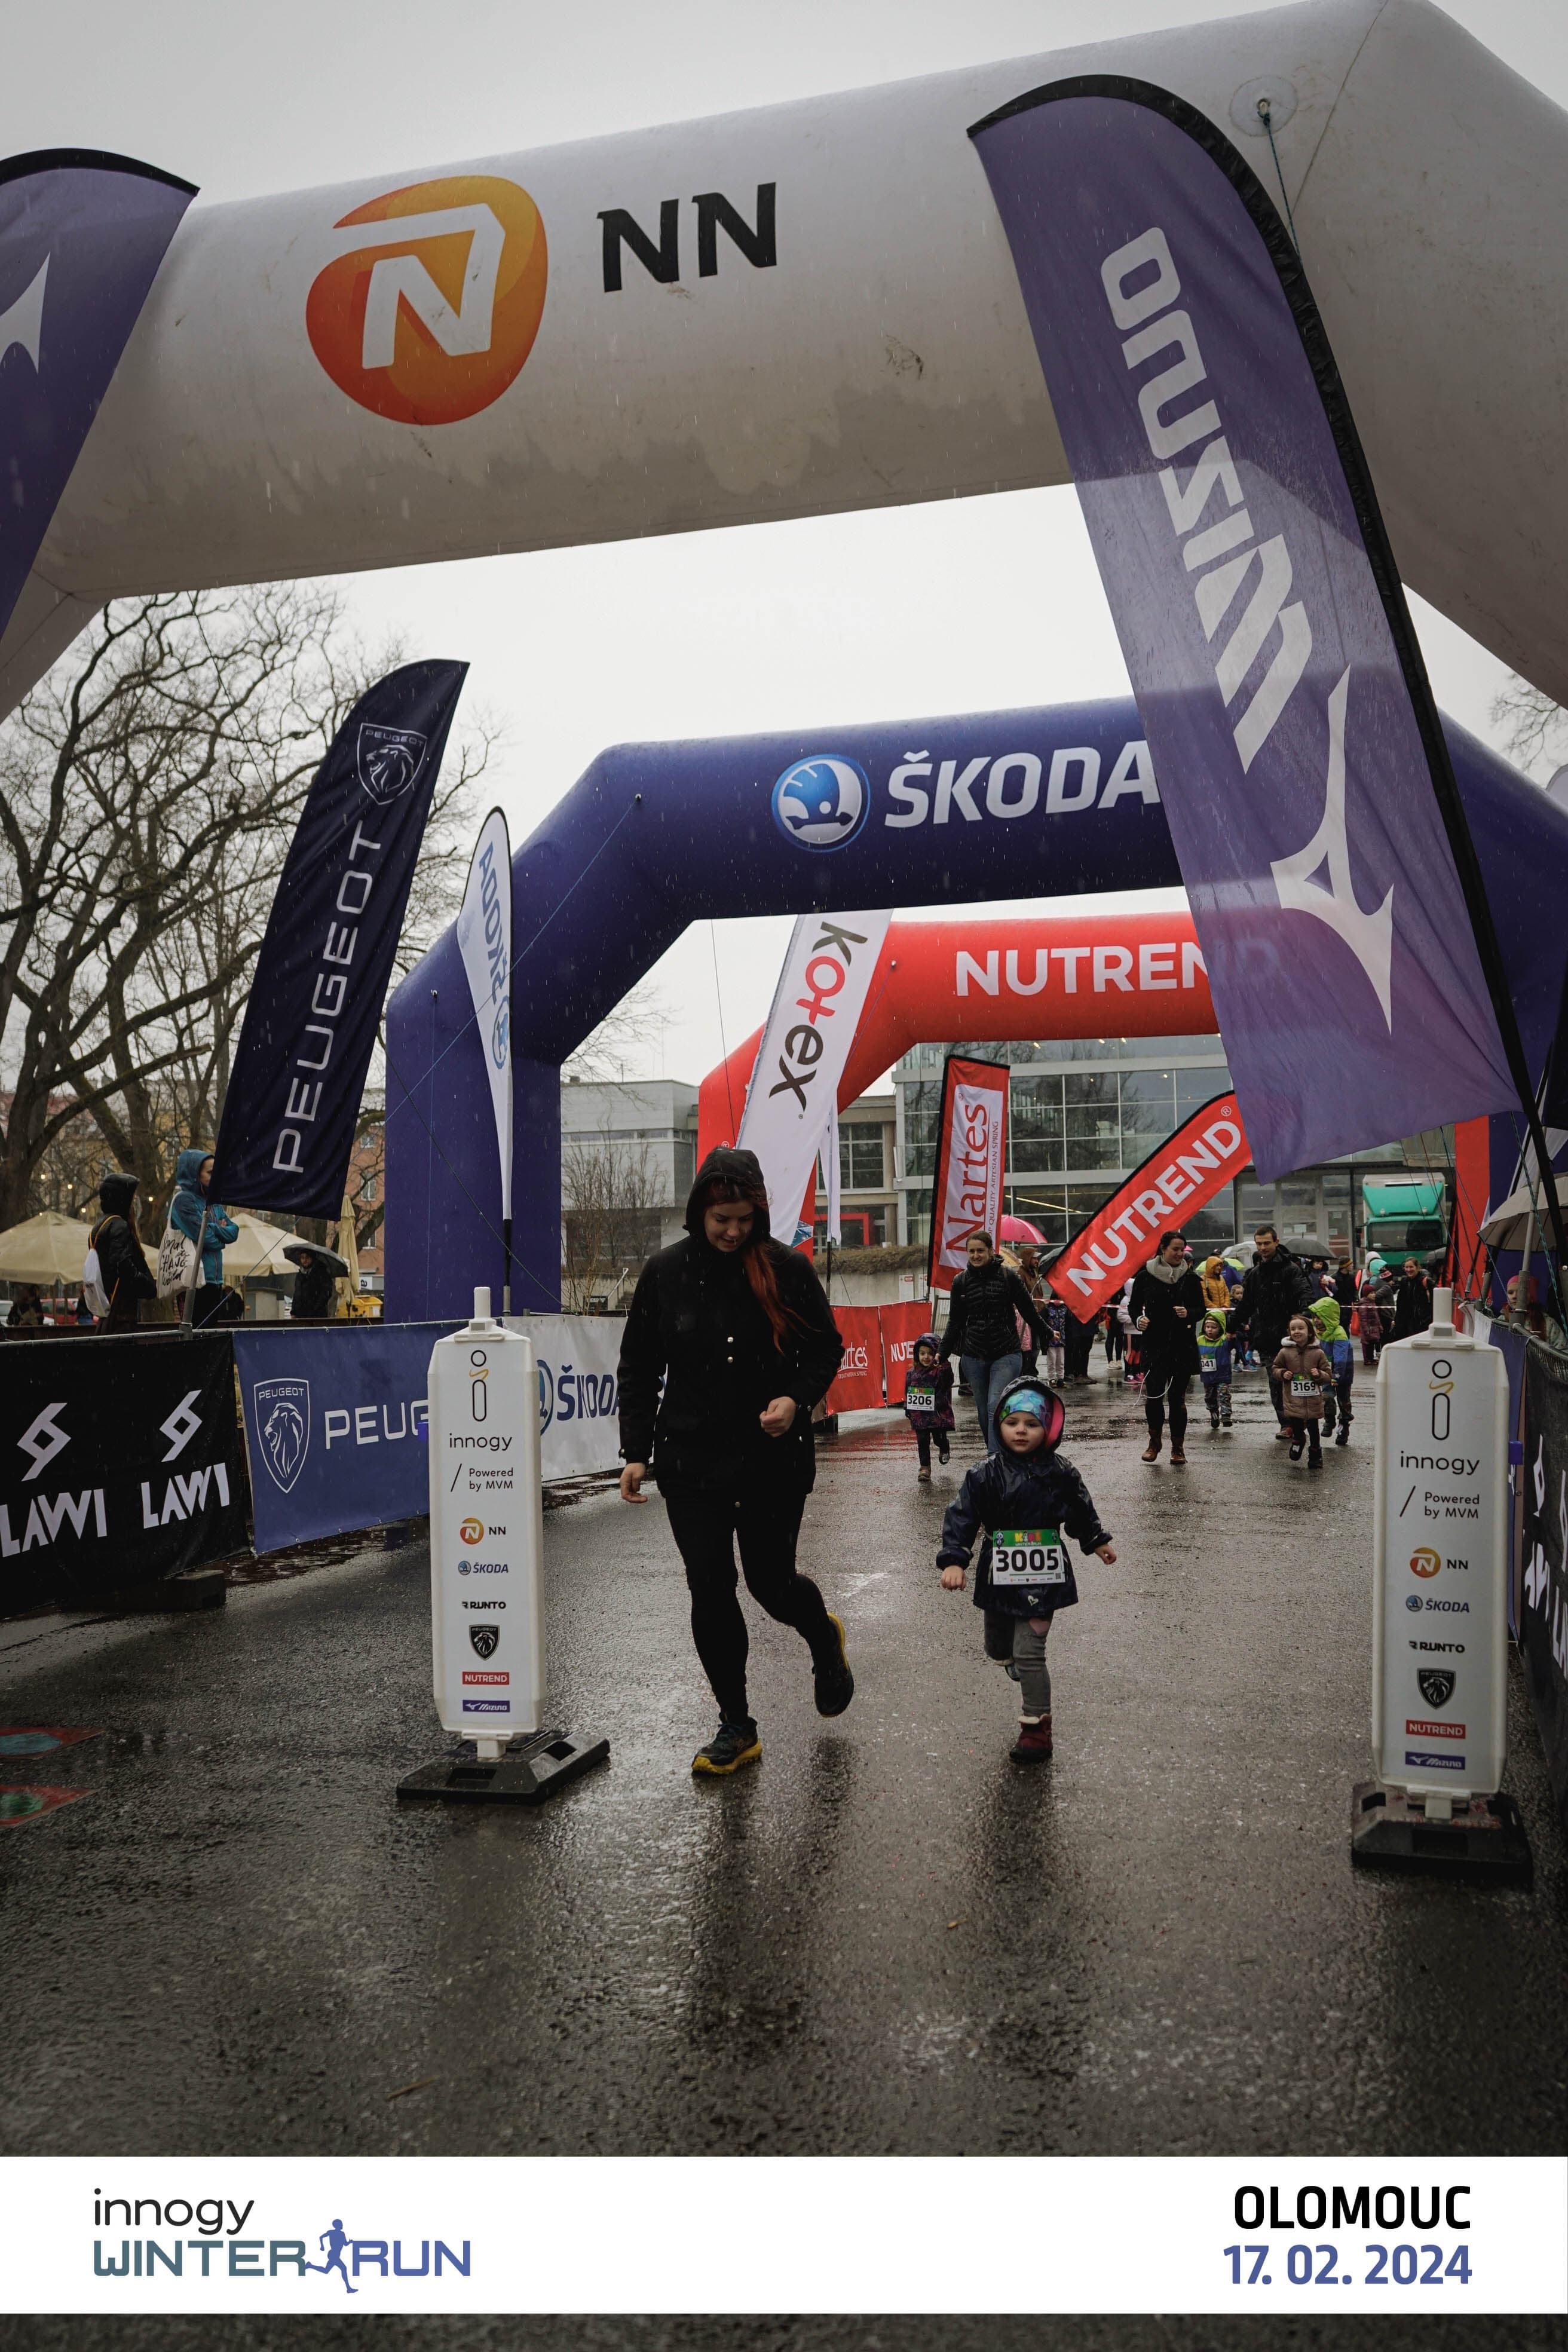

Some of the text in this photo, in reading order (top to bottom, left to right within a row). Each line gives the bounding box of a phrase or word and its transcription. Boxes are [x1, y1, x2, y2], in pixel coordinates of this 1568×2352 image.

[596, 182, 777, 293] NN
[366, 729, 424, 747] PEUGEOT
[884, 740, 1161, 828] ŠKODA
[956, 942, 1208, 997] NUTREN
[272, 819, 381, 1174] PEUGEOT
[945, 1104, 988, 1252] Nartes
[1066, 1120, 1241, 1297] NUTREND
[1293, 1381, 1316, 1392] 3169
[259, 1388, 304, 1401] PEUGEOT
[908, 1395, 932, 1405] 3206
[449, 1433, 512, 1451] innogy
[1400, 1450, 1480, 1475] innogy
[469, 1467, 513, 1477] Powered
[469, 1481, 513, 1492] by MVM
[140, 1462, 230, 1529] LAWI
[1425, 1492, 1480, 1505] Powered
[1425, 1506, 1478, 1519] by MVM
[0, 1489, 108, 1557] LAWI
[488, 1526, 506, 1535] NN
[996, 1548, 1059, 1572] 3005
[1446, 1558, 1468, 1570] NN
[473, 1562, 509, 1573] ŠKODA
[470, 1601, 506, 1609] RUNTO
[1425, 1597, 1470, 1613] ŠKODA
[1419, 1642, 1465, 1653] RUNTO
[465, 1674, 507, 1683] NUTREND
[1409, 1723, 1463, 1736] NUTREND
